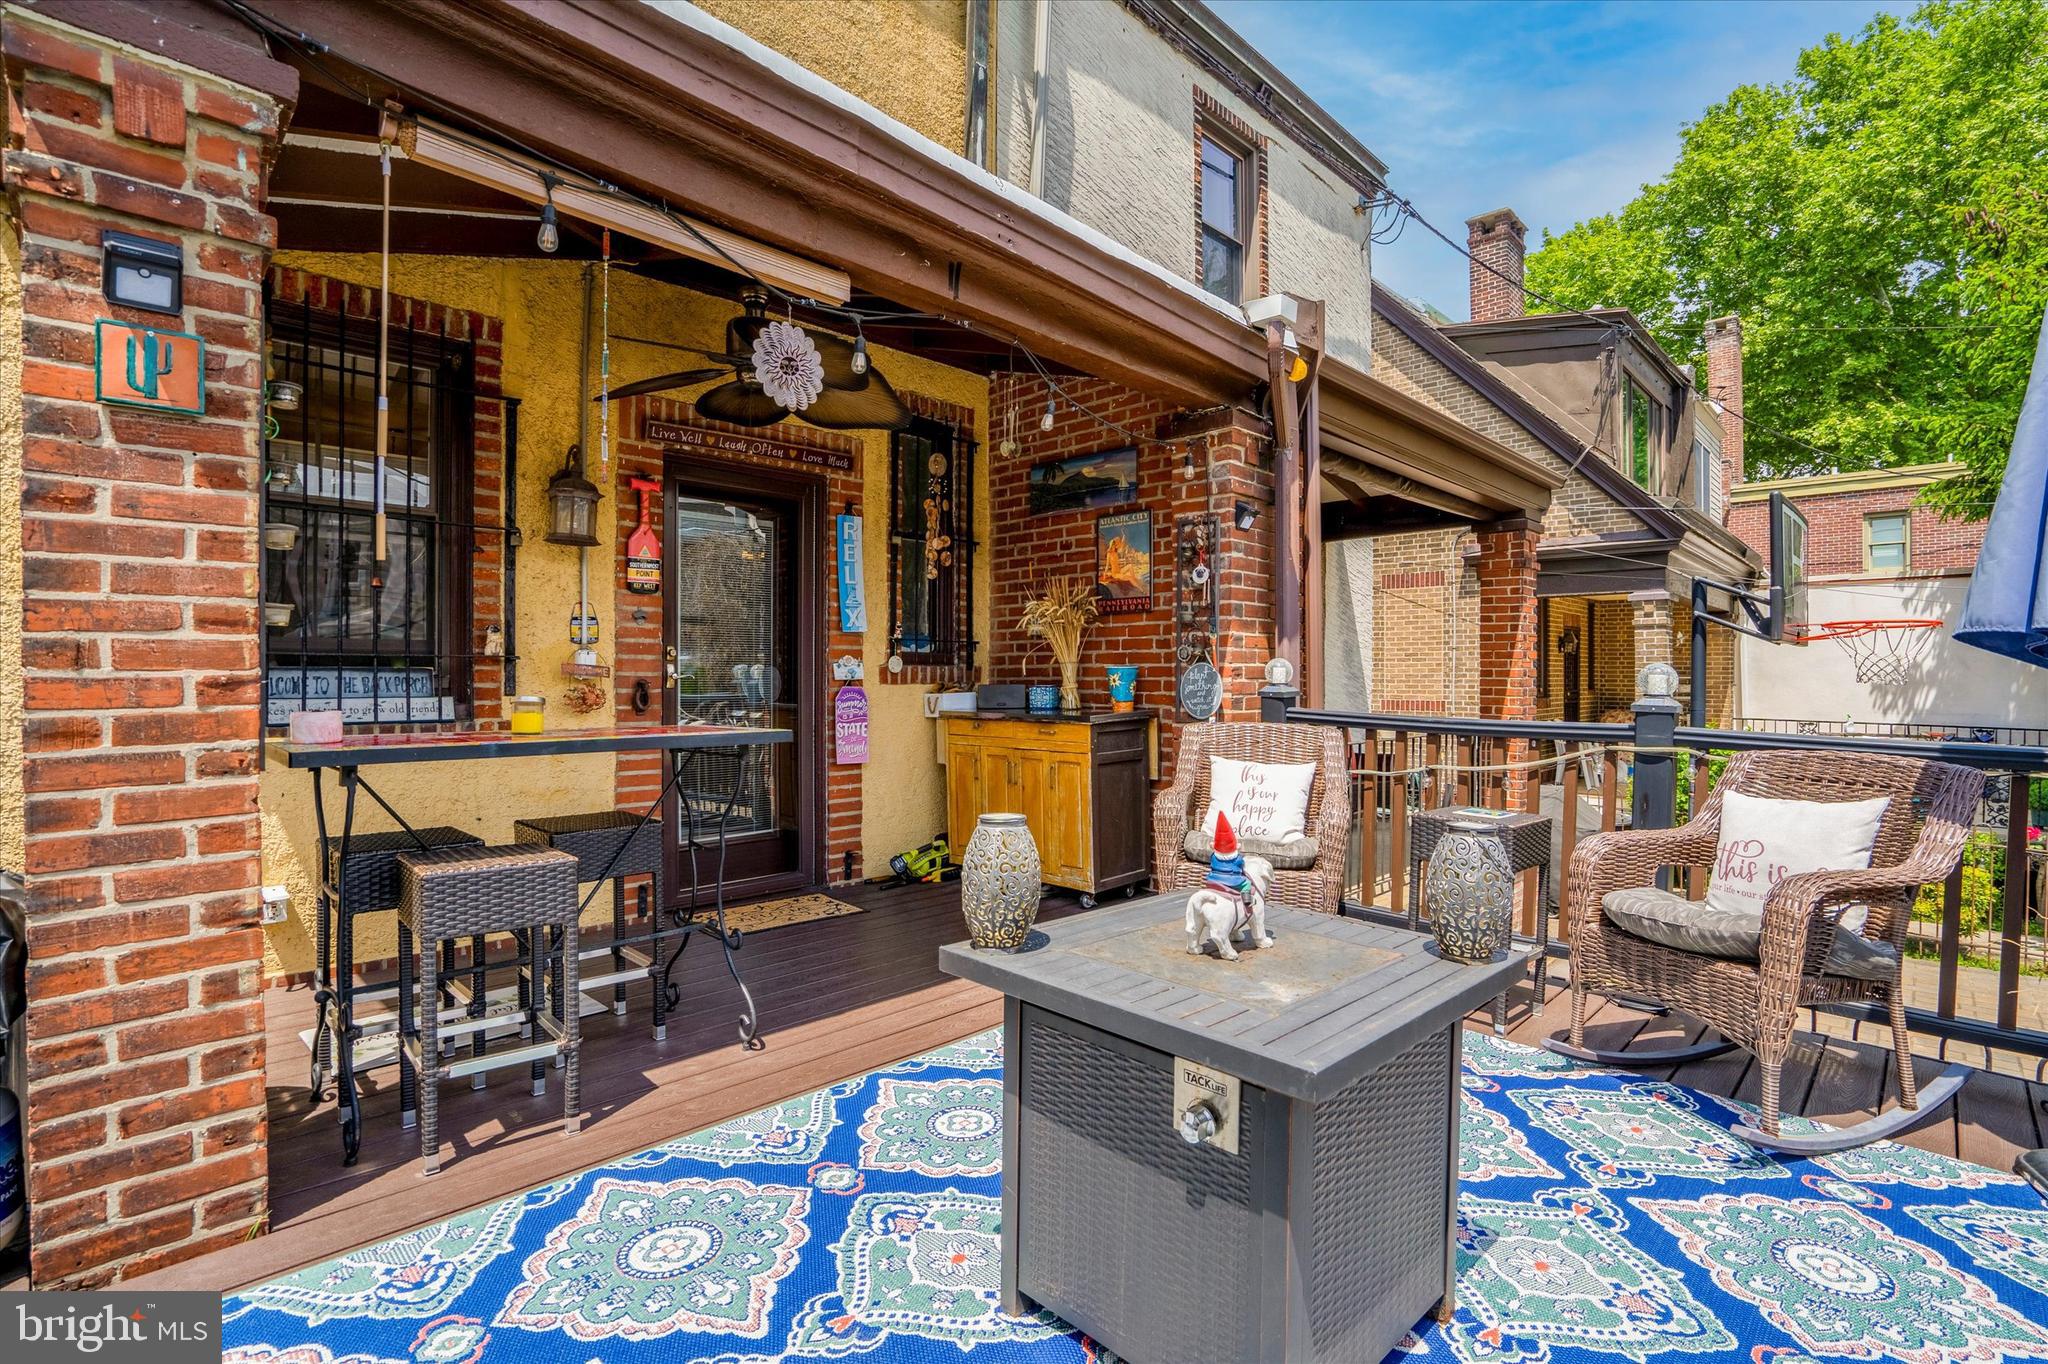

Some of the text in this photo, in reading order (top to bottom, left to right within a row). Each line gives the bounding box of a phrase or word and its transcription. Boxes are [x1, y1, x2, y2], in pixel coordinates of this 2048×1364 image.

[651, 426, 676, 440] Live
[680, 430, 703, 445] Well
[751, 442, 784, 458] Often
[802, 451, 823, 464] Love
[828, 455, 849, 469] Much
[1100, 515, 1131, 525] ATLANTIC
[1132, 512, 1149, 521] CITY
[843, 521, 863, 628] RELAX
[1098, 598, 1150, 607] PENNSYLVANIA
[1099, 604, 1150, 612] RAILROAD
[313, 676, 330, 695] TO
[335, 676, 359, 693] HE
[350, 706, 359, 715] to
[362, 706, 385, 716] grw
[389, 703, 405, 714] old
[836, 722, 868, 737] STATE
[1233, 790, 1277, 822] happy
[1718, 840, 1788, 884] this is
[1741, 890, 1757, 899] our
